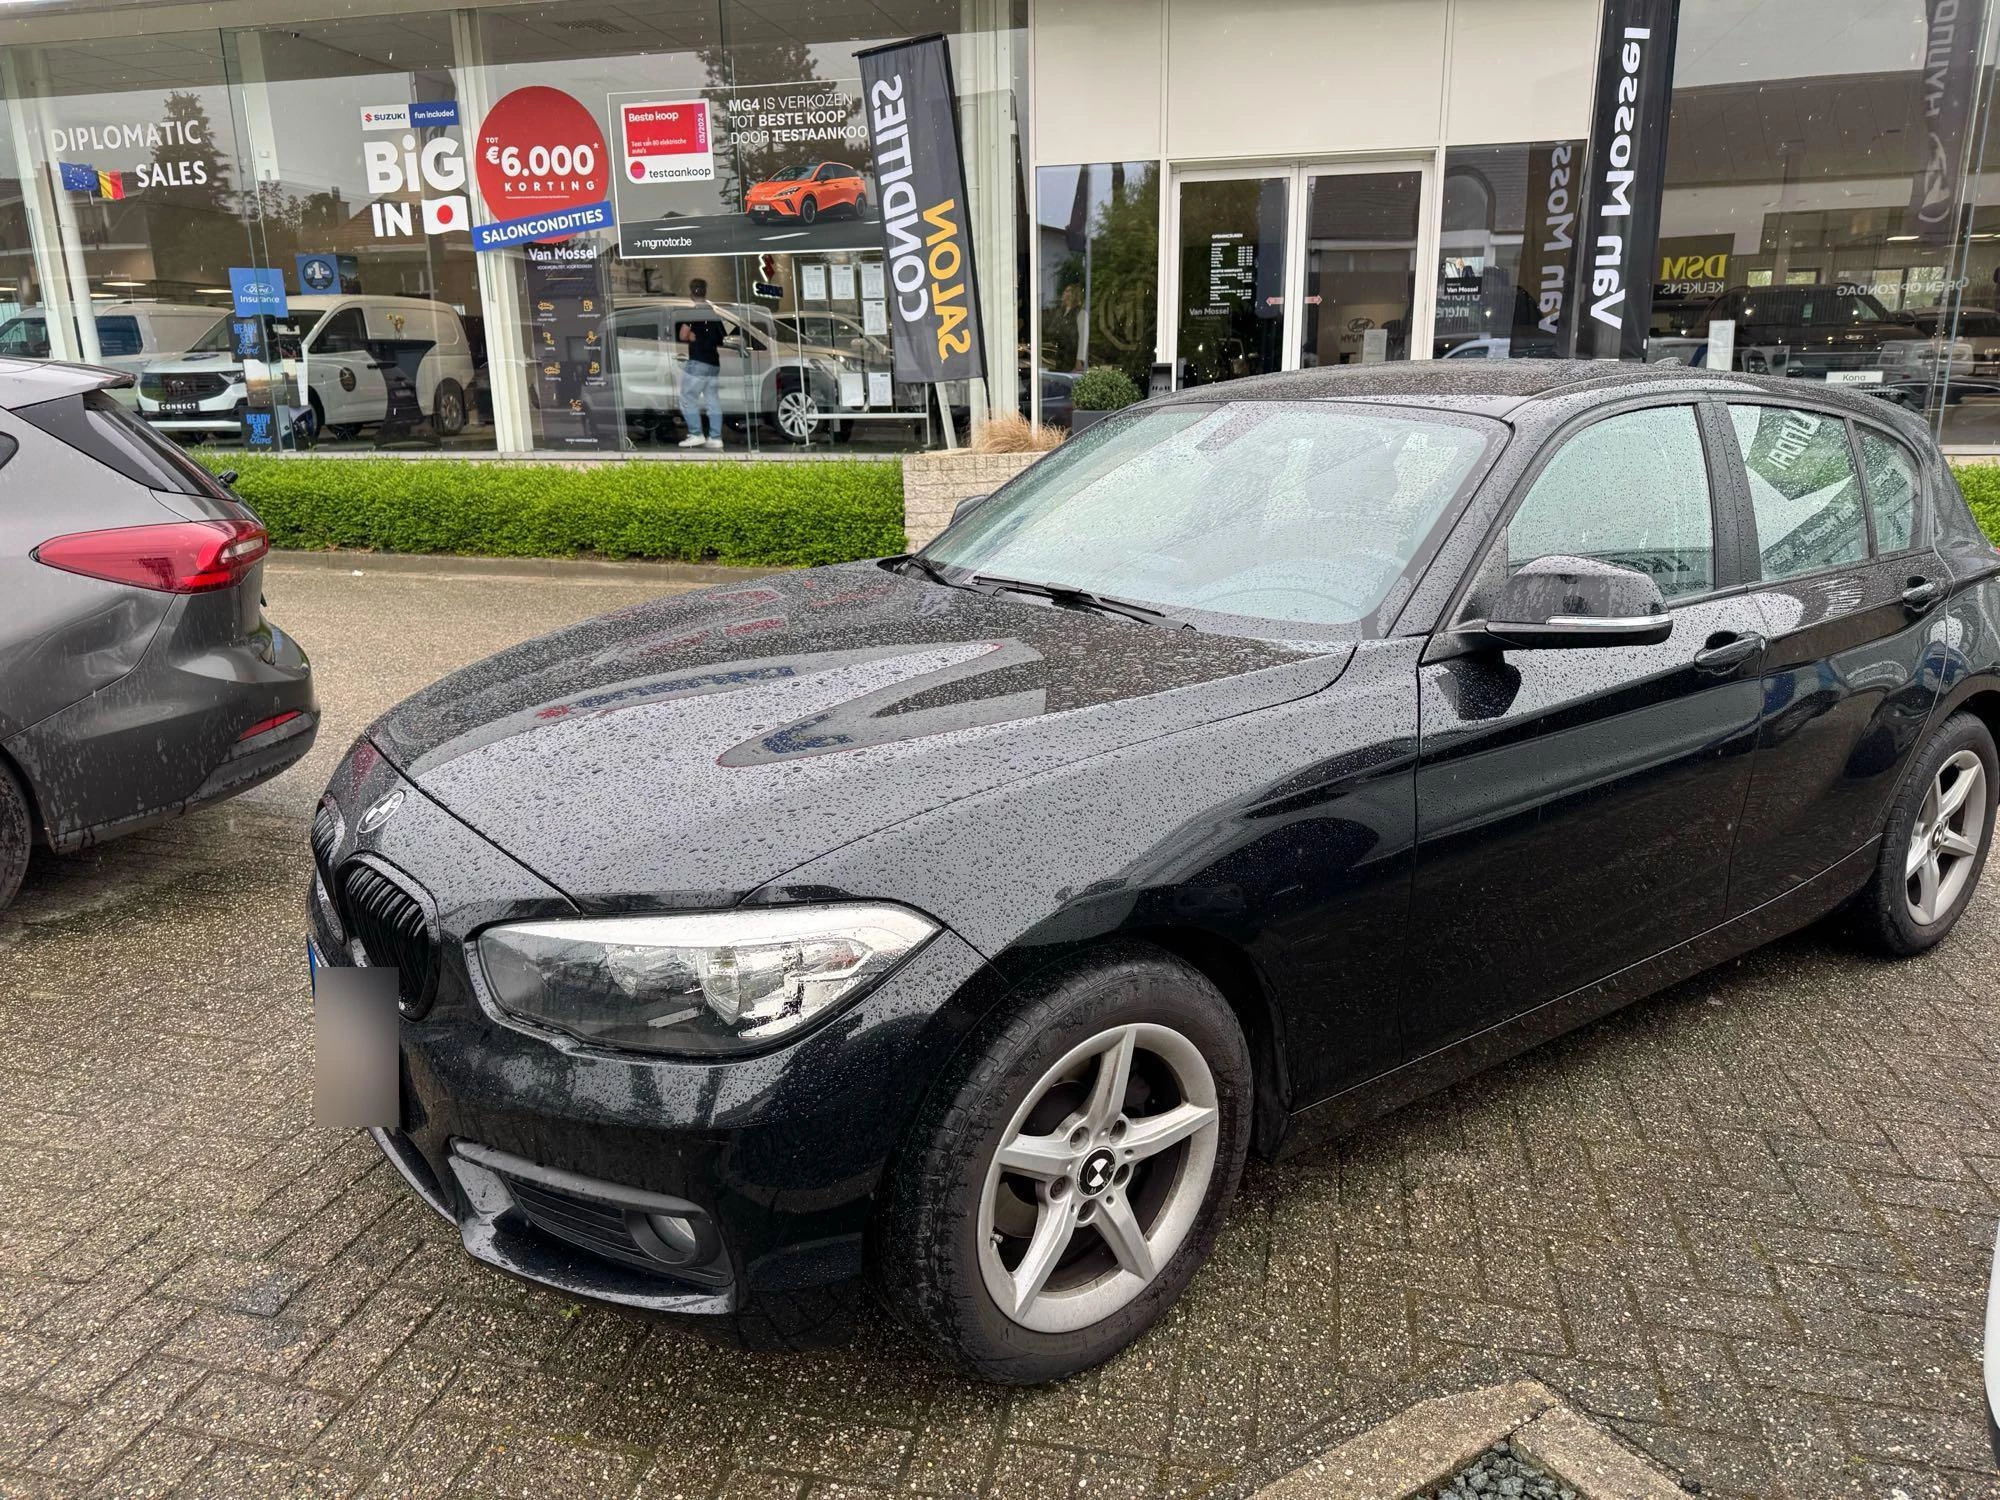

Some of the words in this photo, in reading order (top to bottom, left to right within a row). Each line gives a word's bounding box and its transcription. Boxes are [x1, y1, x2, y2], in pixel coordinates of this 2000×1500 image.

[729, 98, 760, 112] MG4
[763, 97, 775, 110] IS
[778, 93, 853, 109] VERKOZEN
[374, 112, 406, 121] SUZUKI
[414, 111, 426, 119] fun
[426, 109, 455, 118] included
[628, 112, 654, 122] Beste
[655, 111, 679, 122] koop
[729, 114, 755, 129] TOT
[759, 112, 803, 127] BESTE
[806, 110, 846, 124] KOOP
[697, 113, 706, 144] 03/2024
[51, 120, 202, 151] DIPLOMATIC
[730, 131, 769, 144] DOOR
[135, 160, 207, 188] SALES
[648, 167, 711, 179] testaankoop
[504, 181, 595, 192] KORTING
[372, 202, 413, 237] IN
[482, 209, 603, 243] SALONCONDITIES
[642, 237, 692, 249] mgmotor.be
[528, 248, 551, 261] Van
[554, 245, 597, 260] Mossel
[247, 284, 270, 294] Ford
[240, 295, 280, 303] Insurance
[1189, 308, 1203, 316] Van
[1204, 306, 1230, 315] Mossel
[233, 323, 257, 335] READY
[246, 413, 271, 424] READY
[253, 424, 267, 435] SET
[250, 434, 272, 444] Ford
